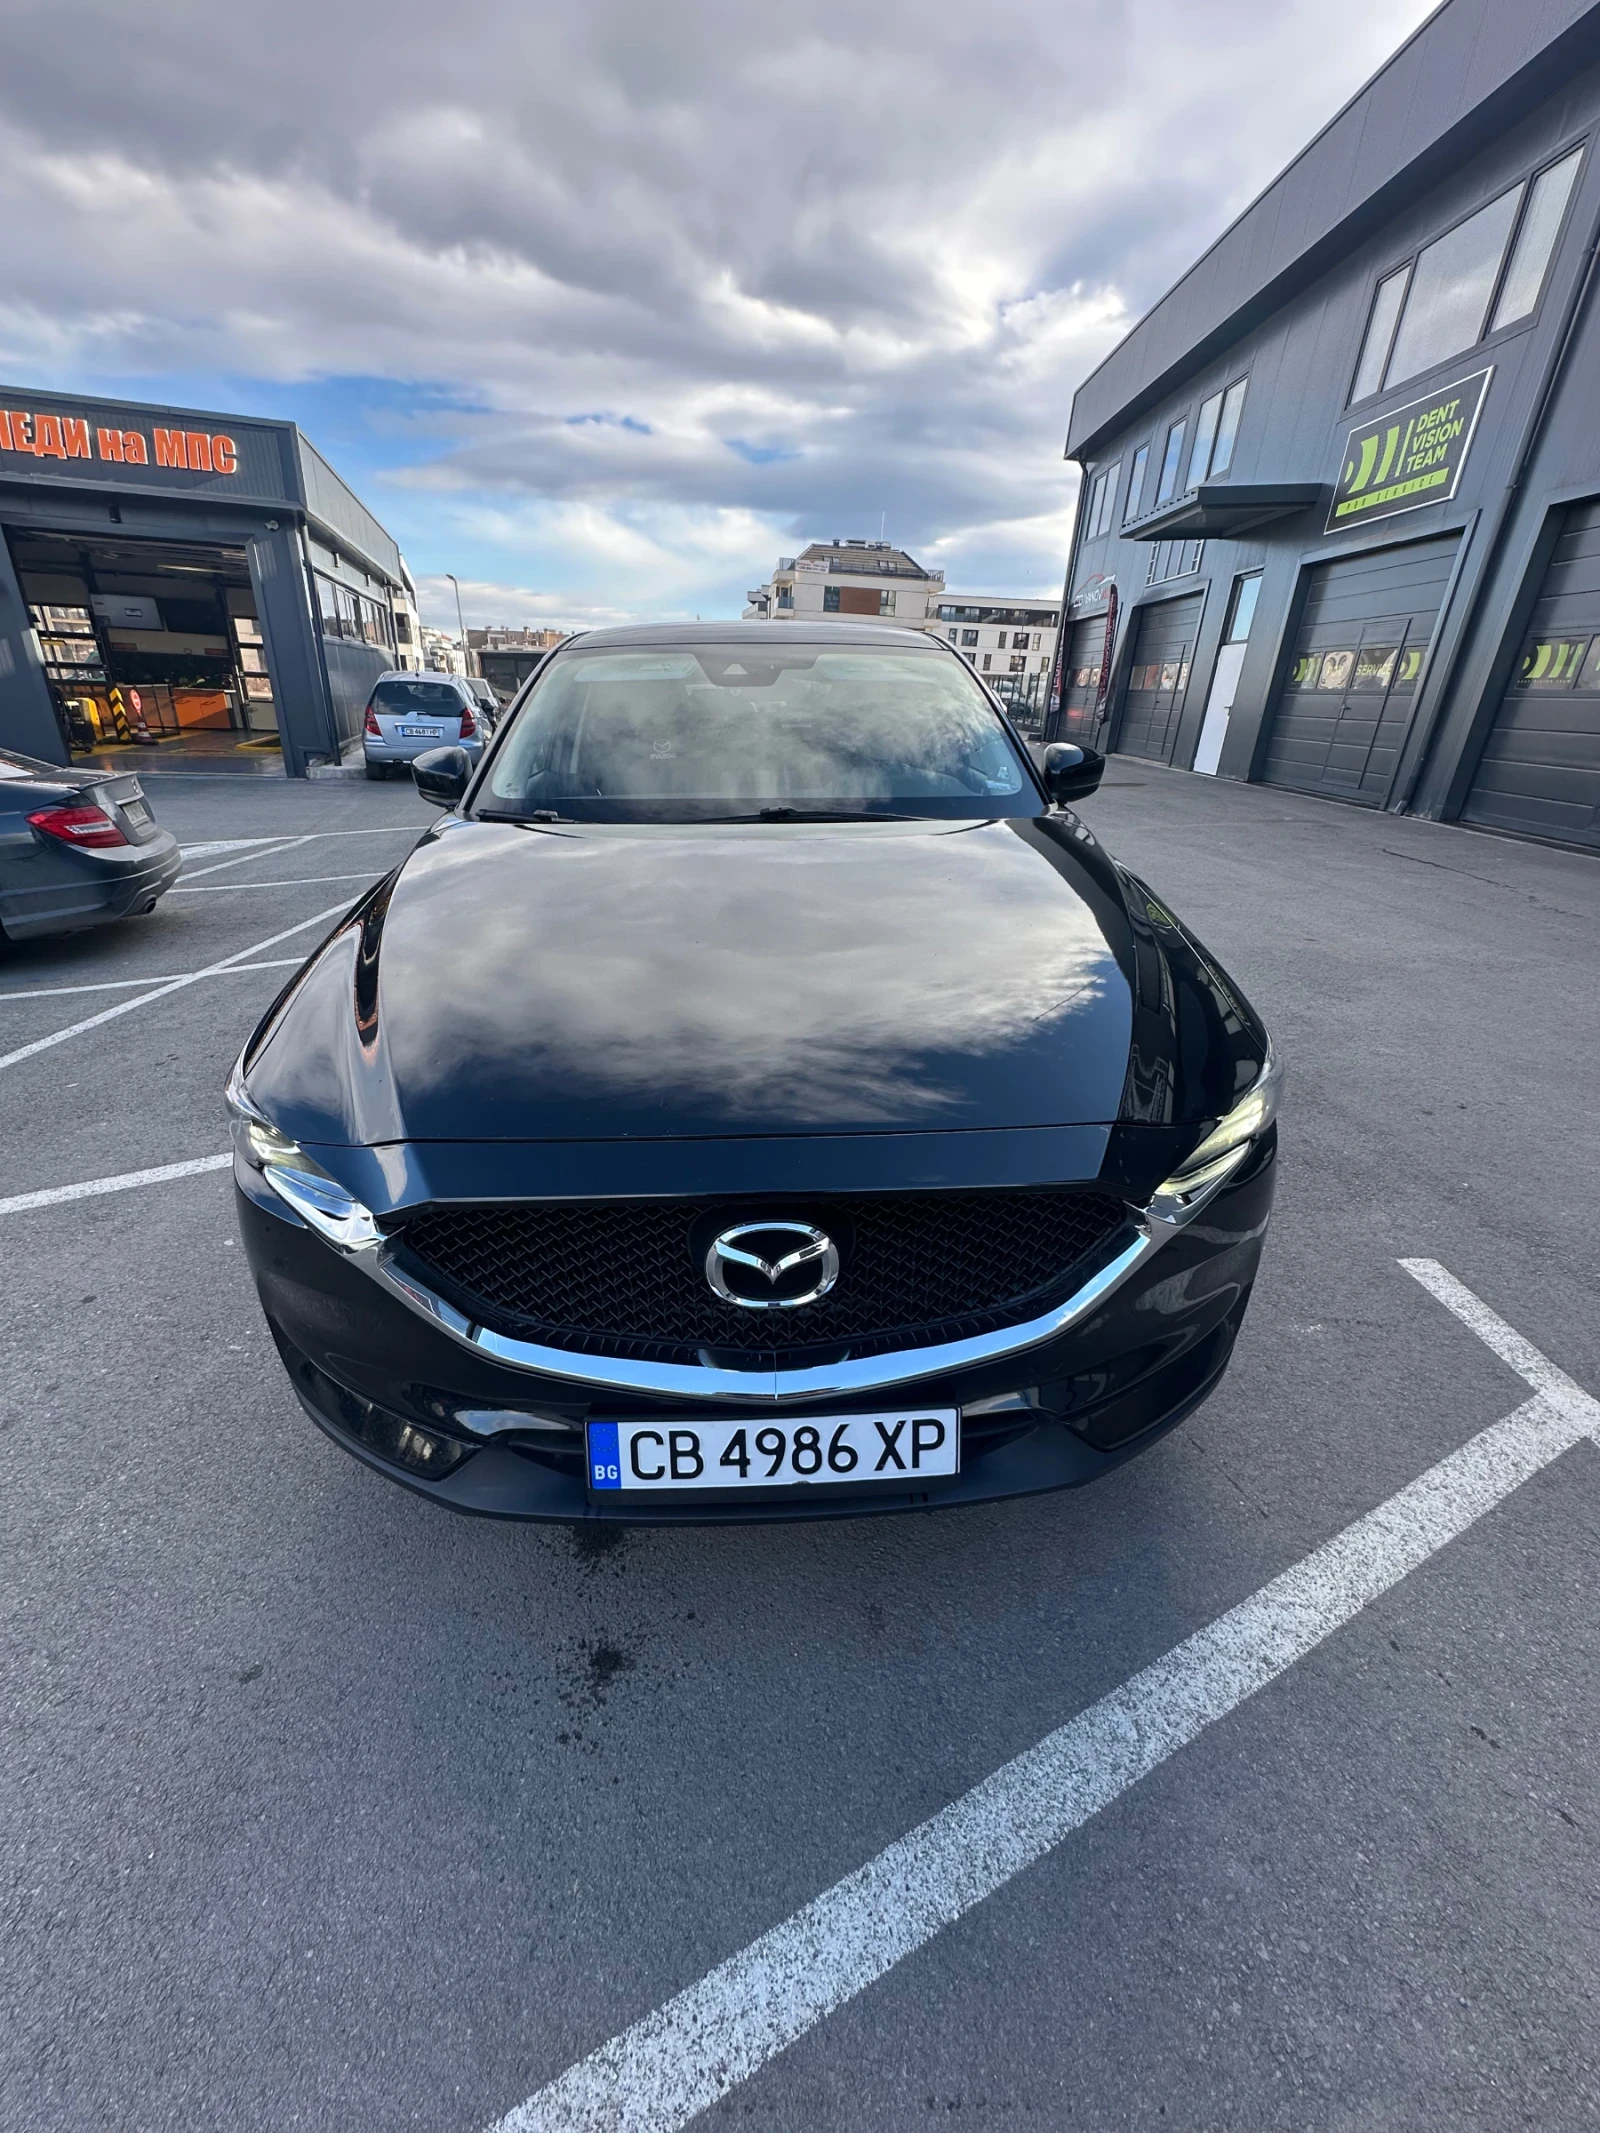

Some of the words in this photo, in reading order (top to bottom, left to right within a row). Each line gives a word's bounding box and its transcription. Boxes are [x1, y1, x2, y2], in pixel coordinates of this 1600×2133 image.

[1416, 399, 1460, 432] DENT
[1412, 417, 1464, 453] VISION
[97, 428, 149, 465] на
[153, 428, 237, 474] МПС
[1406, 443, 1448, 473] TEAM
[1376, 475, 1434, 501] SERVICE
[1355, 663, 1394, 677] SERVICE
[629, 1430, 704, 1480] CB
[719, 1423, 858, 1478] 4986
[873, 1418, 945, 1471] XP
[594, 1464, 618, 1480] BG
